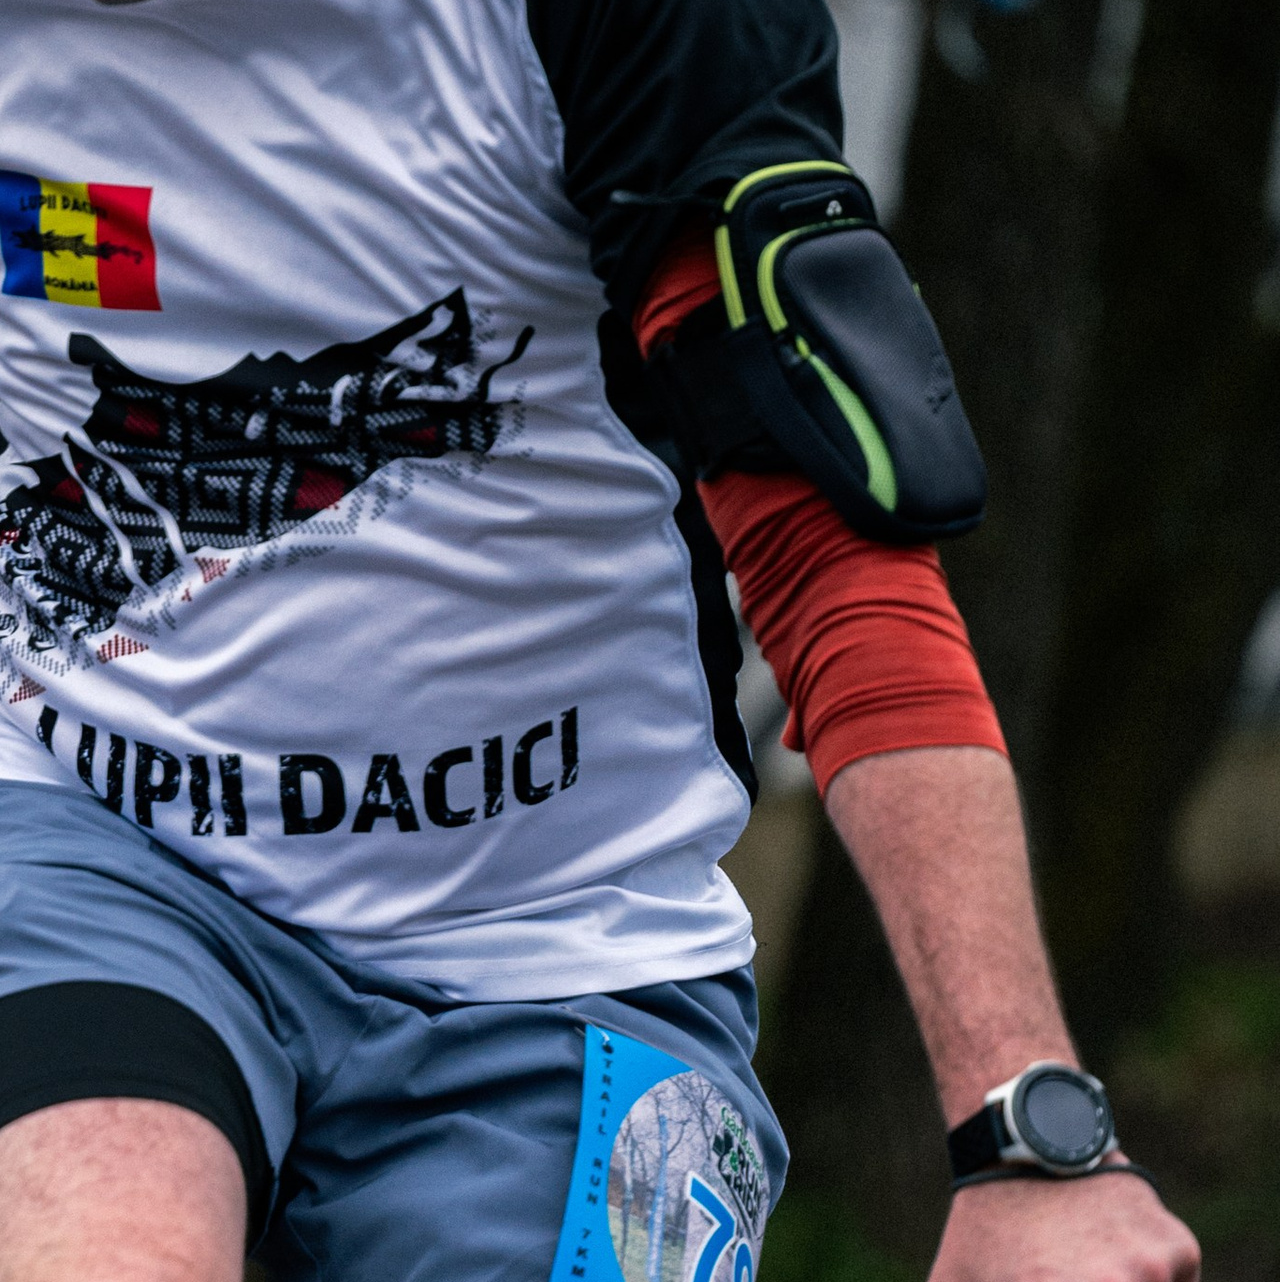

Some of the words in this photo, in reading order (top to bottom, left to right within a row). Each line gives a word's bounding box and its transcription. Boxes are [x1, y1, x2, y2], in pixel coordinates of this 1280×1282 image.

[279, 705, 579, 835] DACICI
[598, 1058, 613, 1136] TRAIL
[586, 1157, 603, 1206] RUN
